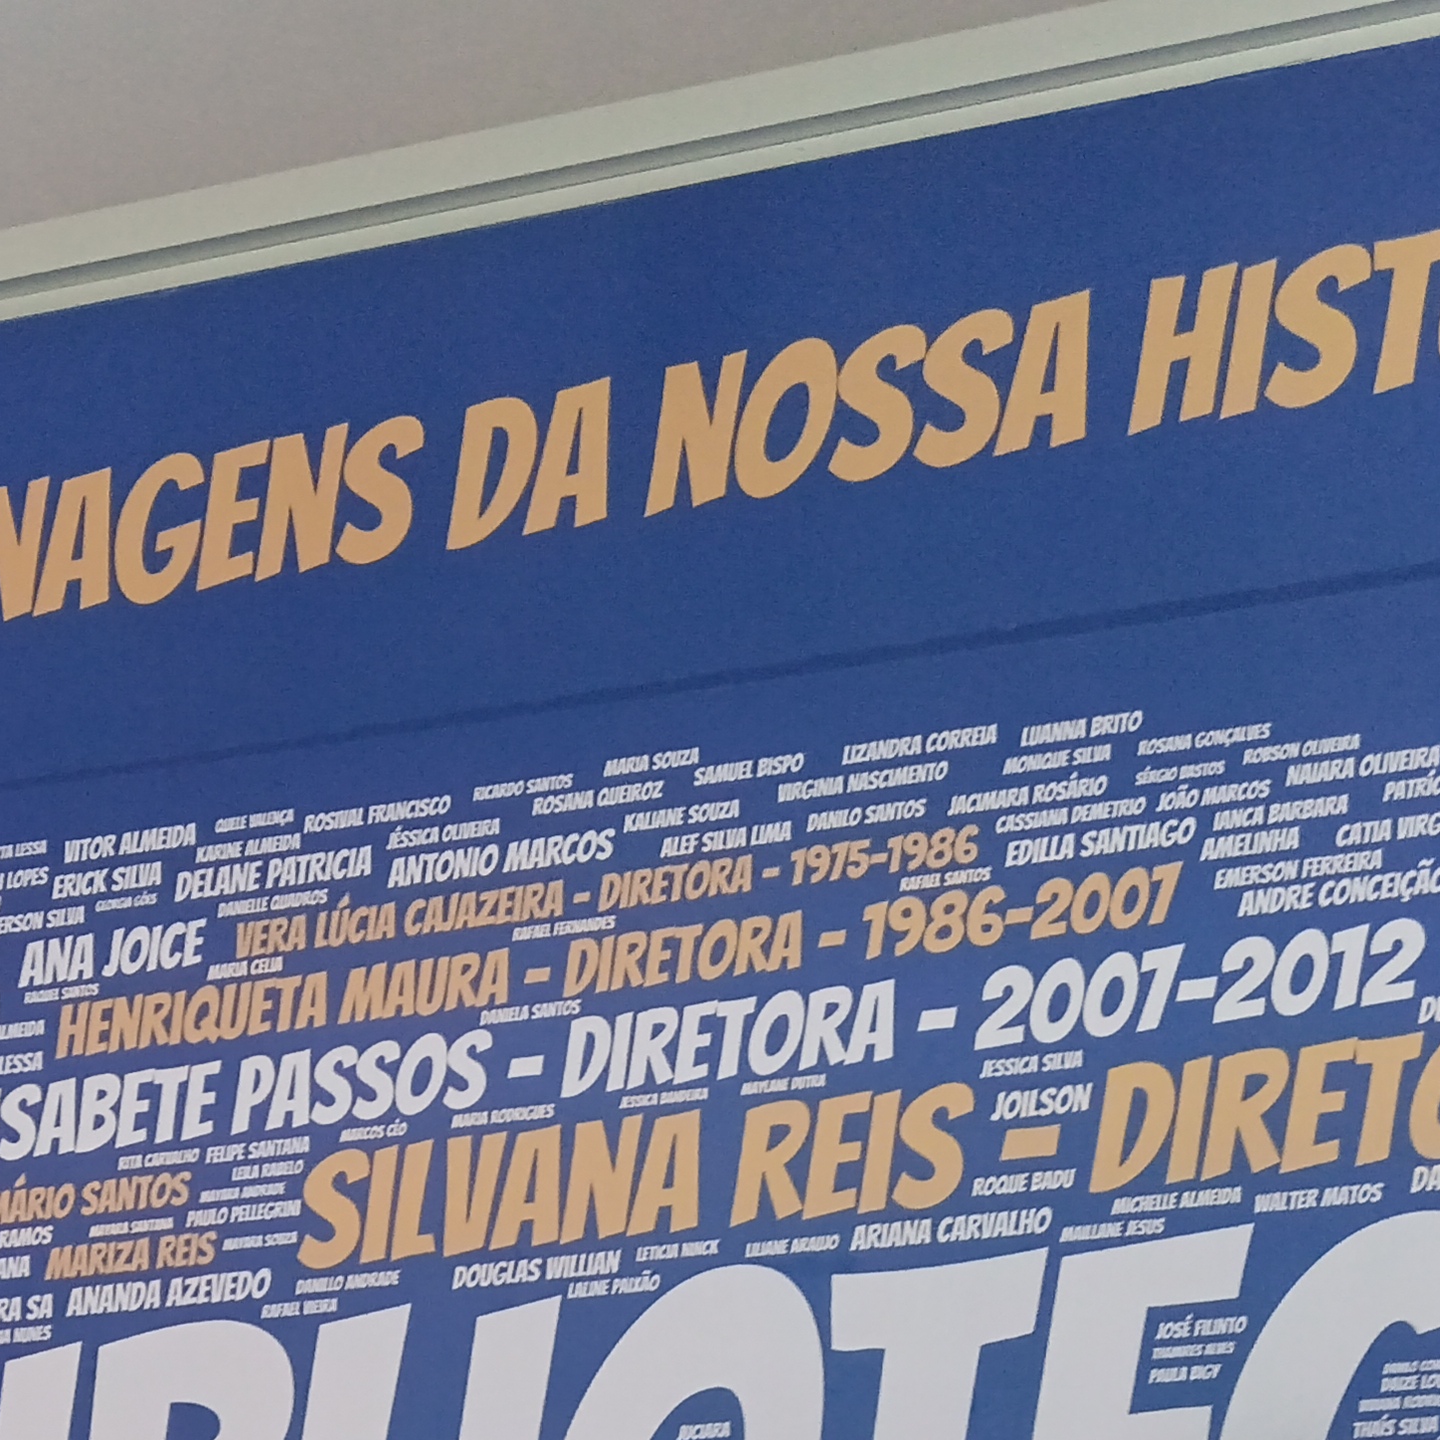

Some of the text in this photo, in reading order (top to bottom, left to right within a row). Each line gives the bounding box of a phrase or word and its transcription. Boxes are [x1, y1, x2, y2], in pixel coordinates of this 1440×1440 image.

[446, 377, 610, 549] DA
[644, 289, 1090, 517] NOSSA
[842, 724, 997, 765] LIZANDRA CORREIA
[388, 829, 615, 888] ANTONIO MARCOS
[1005, 817, 1196, 867] EDILLA SANTIAGO
[175, 845, 371, 902] DELANE PATRICIA
[236, 915, 306, 959] VERA
[315, 894, 395, 948] LÚCIA
[405, 880, 563, 941] CAJAZEIRA
[598, 854, 752, 912] DIRETORA
[791, 825, 980, 891] 1975-1986
[1238, 882, 1315, 917] ANDRE
[18, 918, 206, 988] ANA JOICE
[56, 963, 327, 1059] HENRIQUETA
[338, 948, 510, 1026] MAURA
[562, 910, 802, 997] DIRETORA
[863, 861, 1183, 960] 1986-2007
[231, 1029, 492, 1136] PASSOS
[560, 979, 895, 1099] DIRETORA
[974, 918, 1425, 1050] 2007-2012
[81, 1172, 191, 1215] SANTOS
[298, 1109, 701, 1268] SILVANA
[730, 1082, 974, 1227] REIS
[45, 1231, 217, 1280] MARIZA REIS
[850, 1207, 1052, 1251] ARIANA CARVALHO
